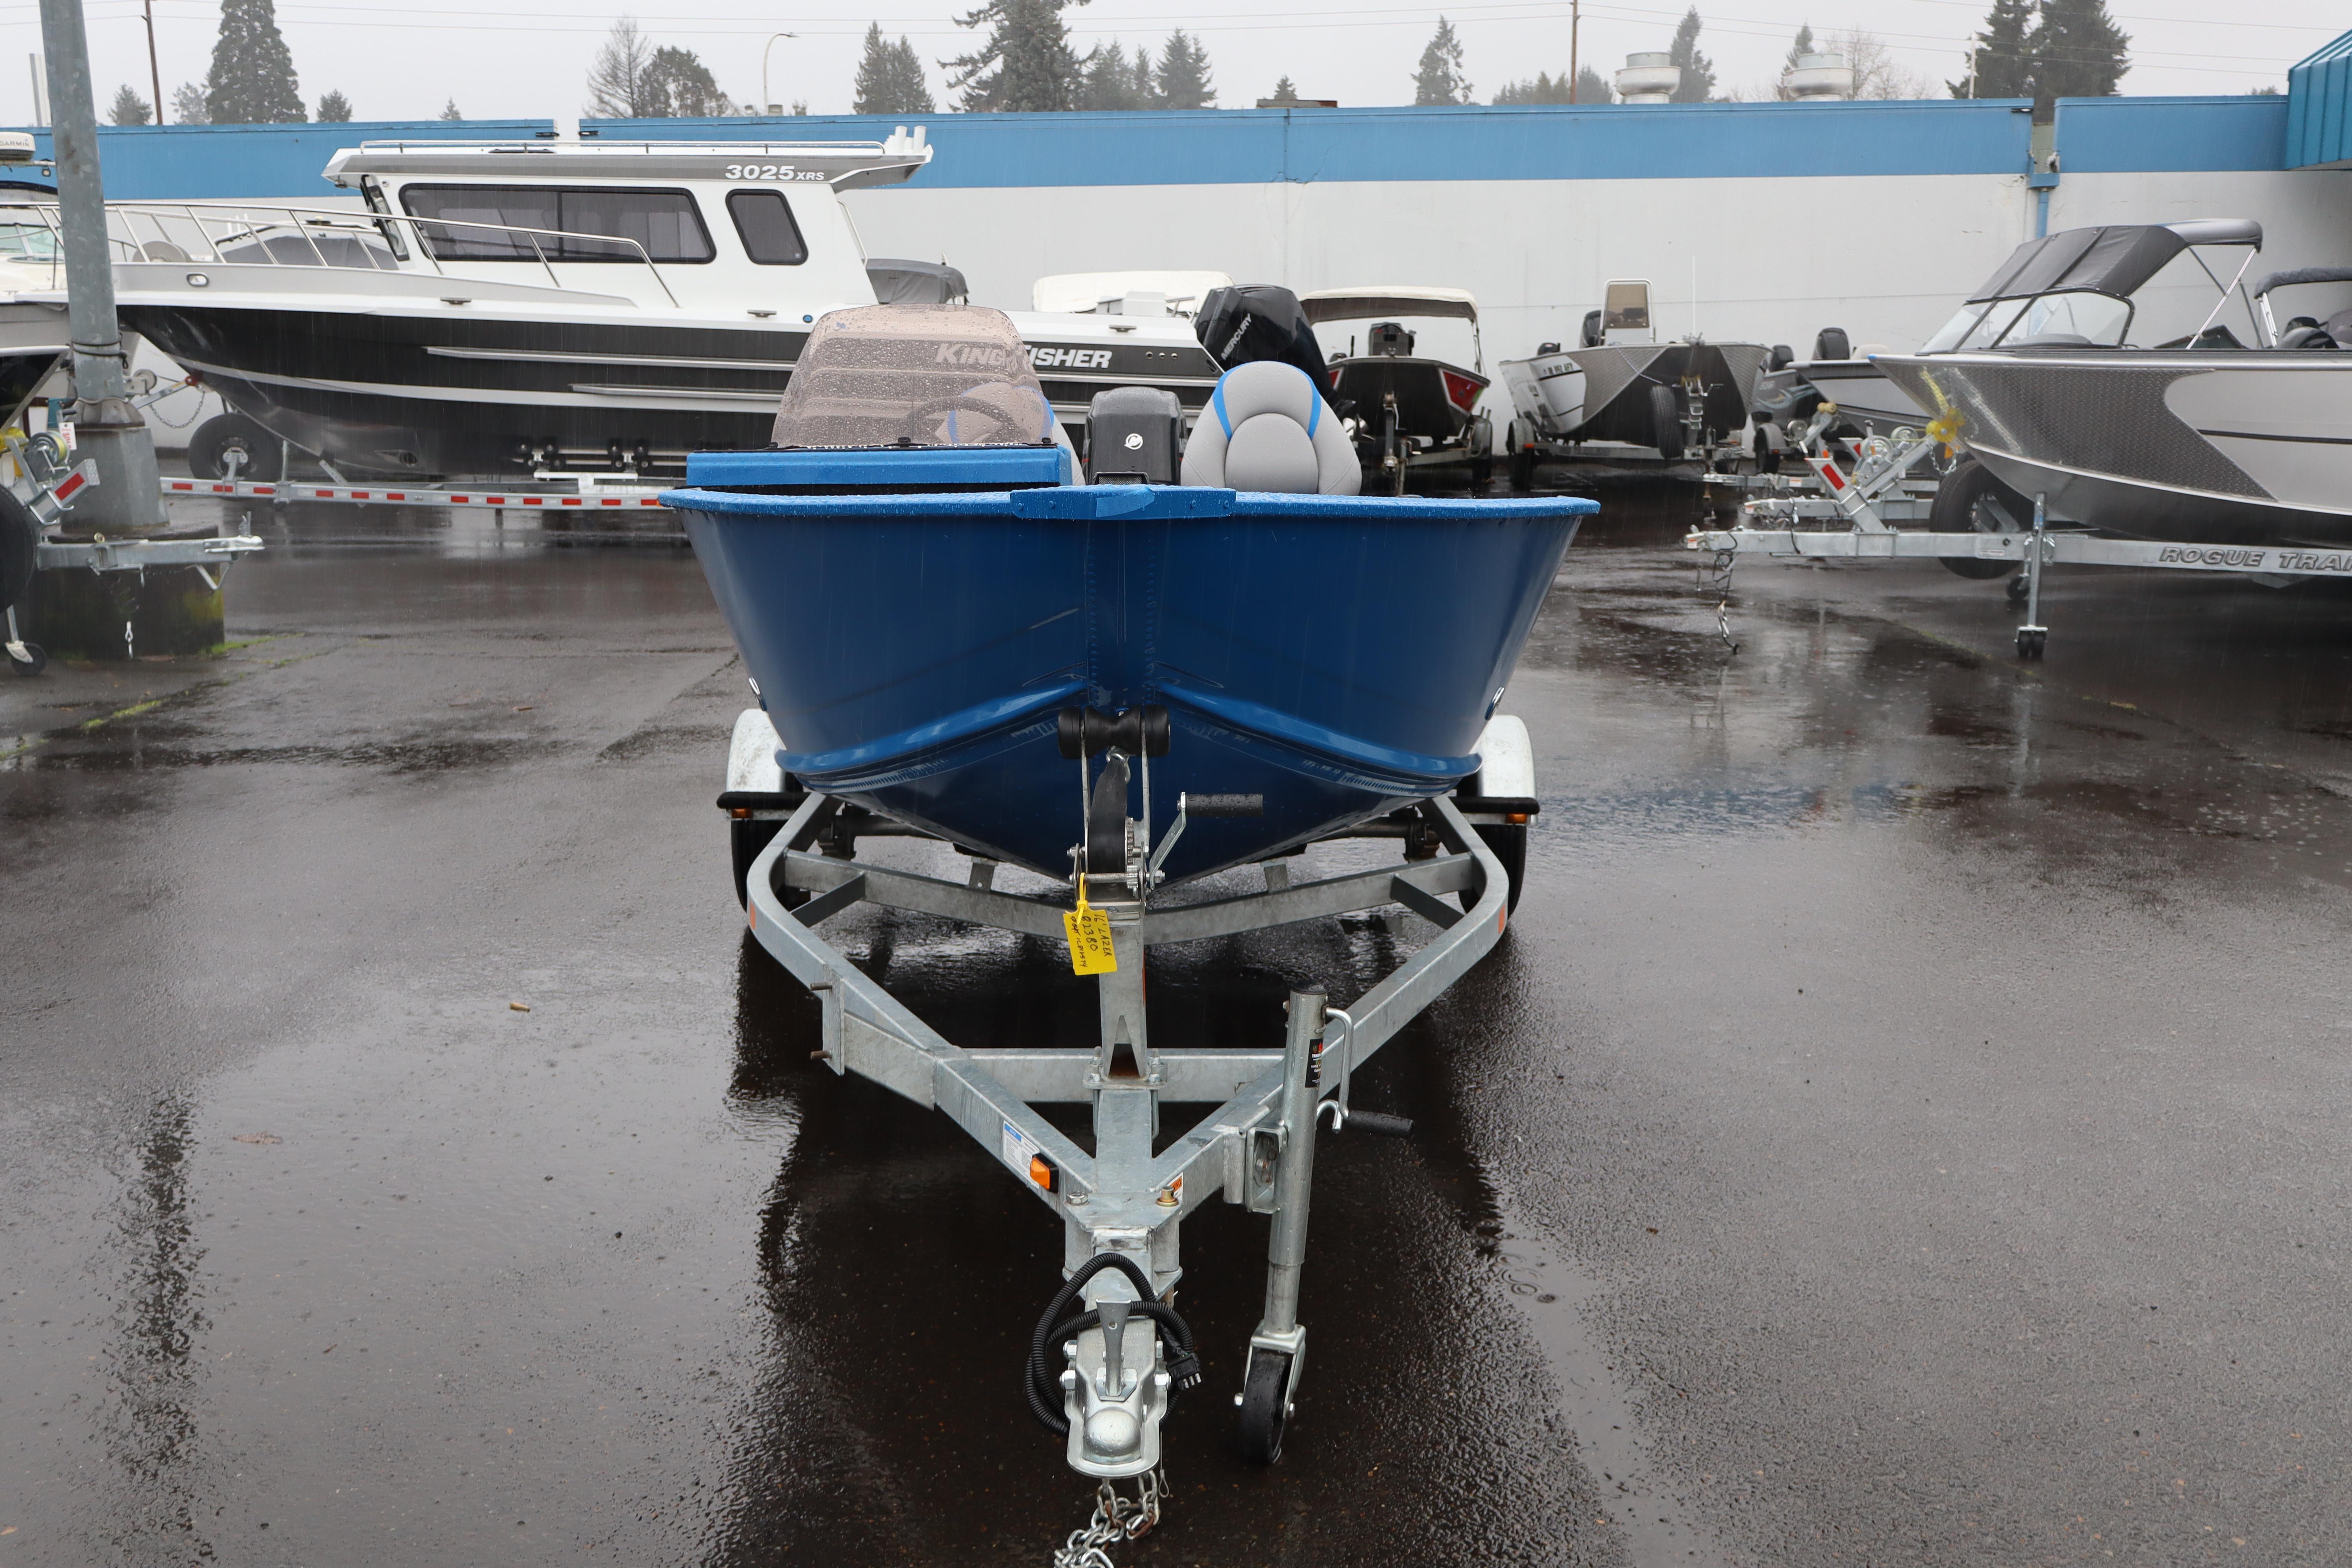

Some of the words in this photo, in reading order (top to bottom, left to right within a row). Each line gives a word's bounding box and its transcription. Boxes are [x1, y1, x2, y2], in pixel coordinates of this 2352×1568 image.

[725, 165, 795, 180] 3025
[795, 172, 825, 181] XRS
[1221, 313, 1252, 360] MERCURY
[2158, 546, 2266, 567] ROGUE
[1081, 916, 1098, 951] 82380
[1098, 928, 1112, 957] LAZER
